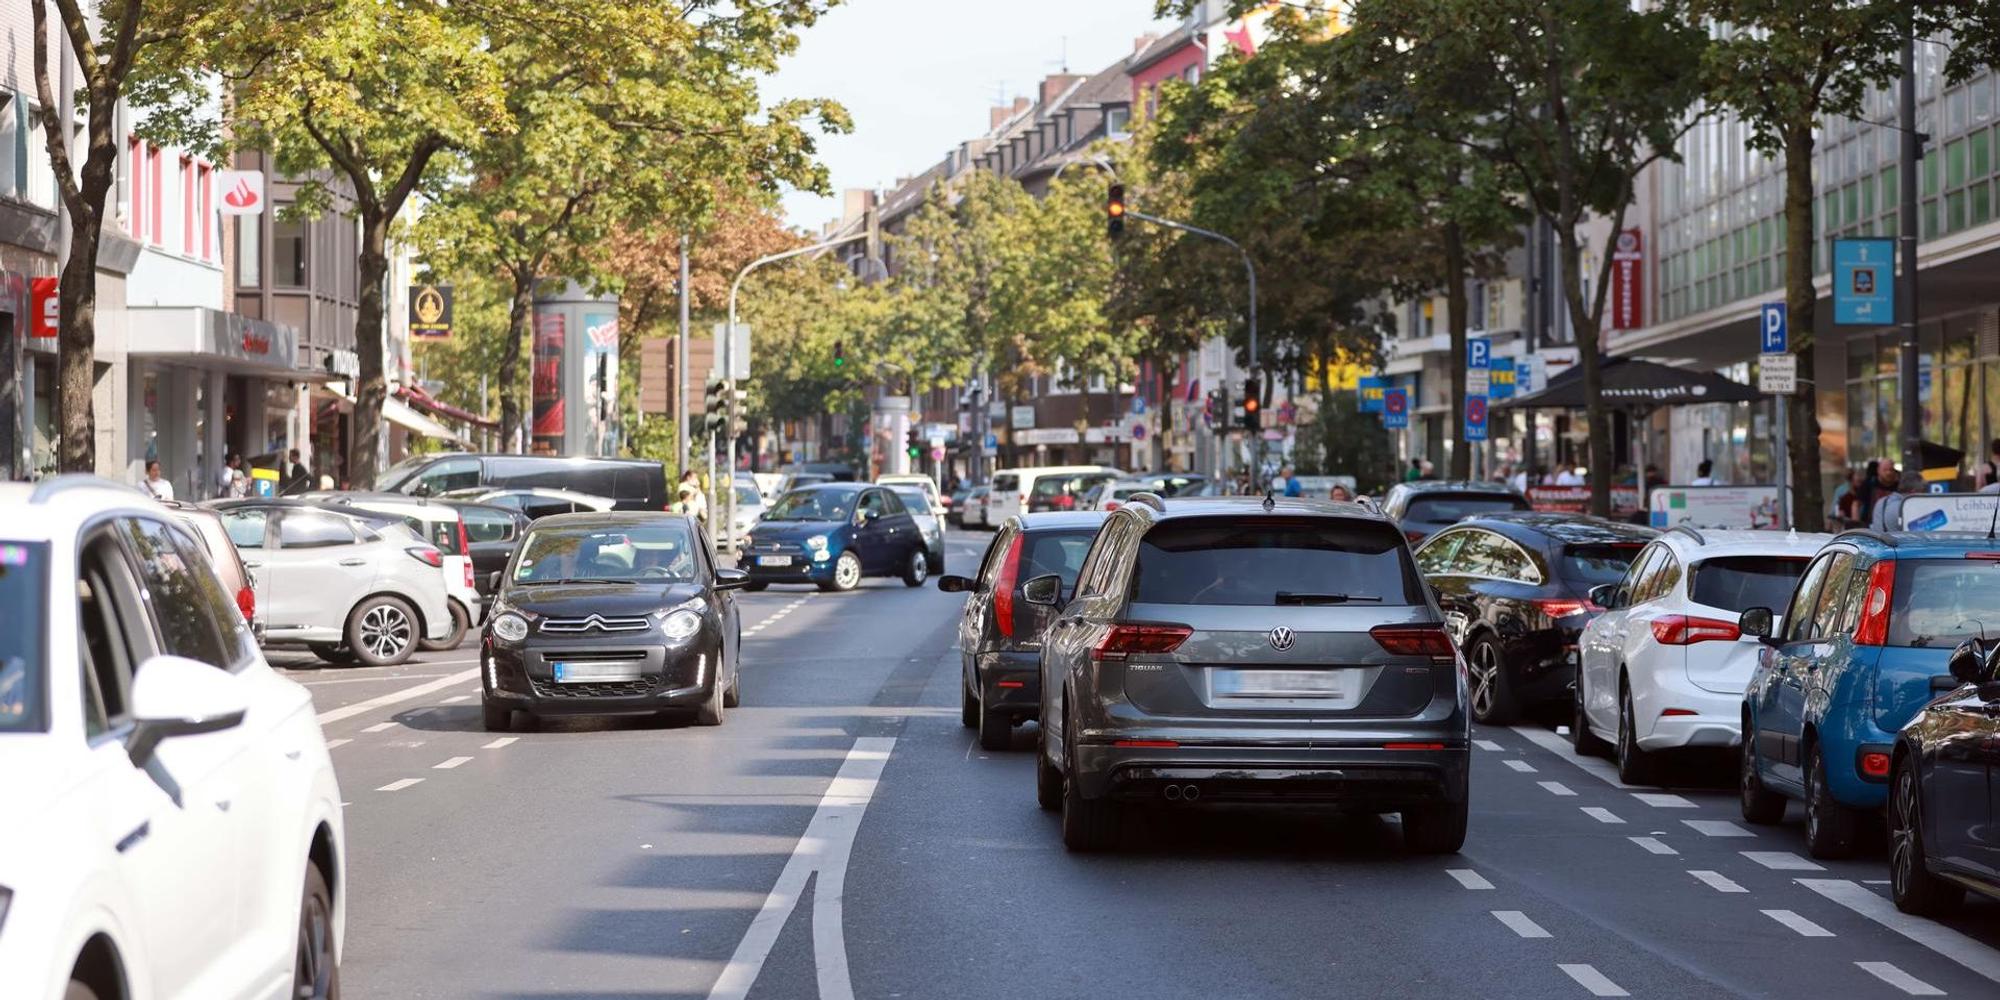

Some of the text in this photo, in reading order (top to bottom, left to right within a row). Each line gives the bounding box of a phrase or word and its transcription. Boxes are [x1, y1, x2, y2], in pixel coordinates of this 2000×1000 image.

[1766, 308, 1781, 347] P
[1472, 341, 1486, 366] P
[1601, 385, 1686, 399] mangal
[1387, 416, 1406, 425] TAXI
[1467, 427, 1486, 437] TAXI
[260, 480, 270, 495] P
